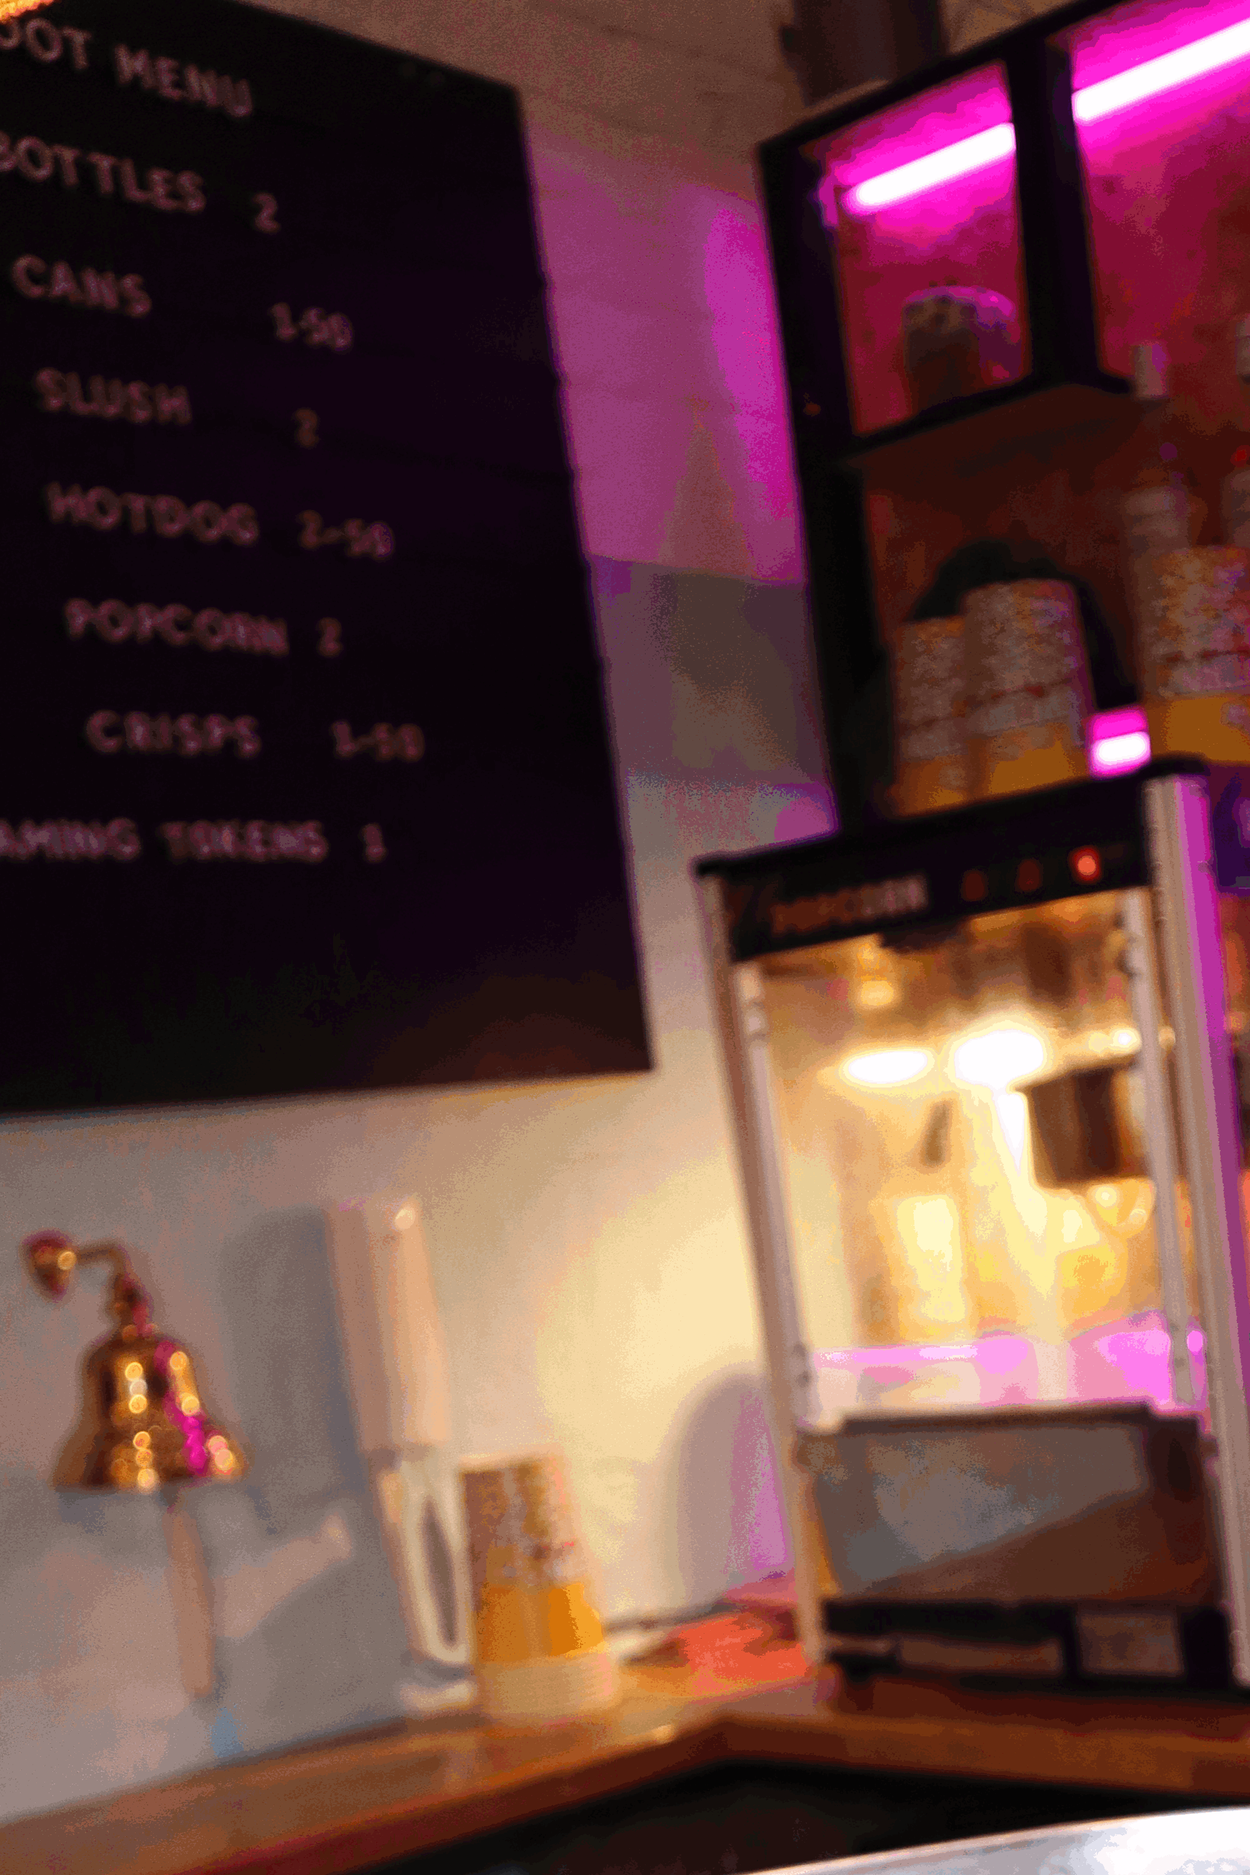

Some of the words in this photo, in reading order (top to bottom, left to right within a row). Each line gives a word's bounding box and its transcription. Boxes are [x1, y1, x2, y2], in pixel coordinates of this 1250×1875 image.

[114, 44, 252, 117] MENU
[255, 194, 280, 233] 2
[12, 255, 152, 317] CANS
[35, 368, 191, 425] SLUSH
[294, 409, 319, 448] 2
[48, 483, 258, 546] HOTDOG
[65, 600, 290, 657] POPCORN
[317, 617, 342, 657] 2
[87, 711, 261, 759] CRISPS
[362, 824, 387, 862] 1
